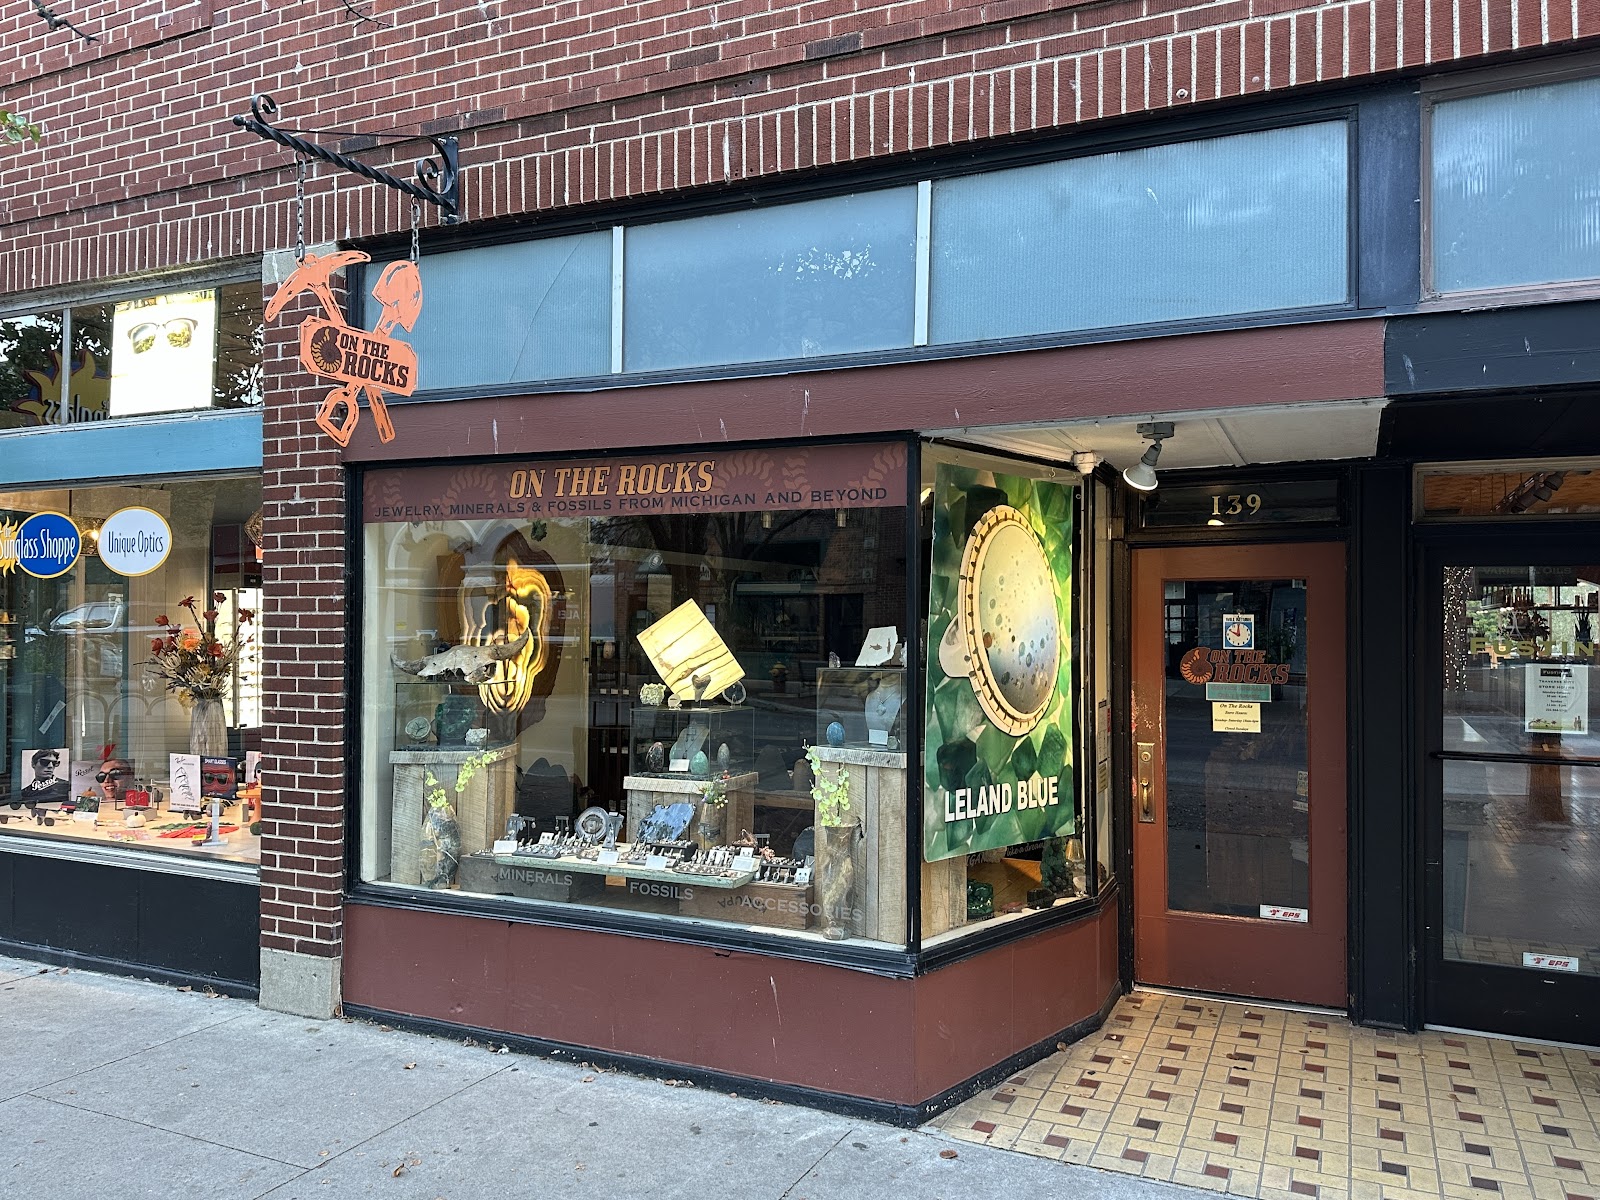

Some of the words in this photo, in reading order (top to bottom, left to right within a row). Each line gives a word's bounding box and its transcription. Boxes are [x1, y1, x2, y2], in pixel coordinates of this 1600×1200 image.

[339, 333, 360, 352] ON
[362, 339, 390, 360] THE
[341, 351, 409, 388] ROCKS
[509, 469, 546, 499] ON
[554, 466, 611, 497] THE
[616, 460, 715, 496] ROCKS
[374, 505, 444, 518] JEWELRY,
[450, 502, 525, 515] MINERALS
[531, 502, 541, 512] &
[547, 499, 612, 512] FOSSILS
[618, 496, 664, 510] FROM
[671, 493, 756, 509] MICHIGAN
[764, 491, 802, 505] AND
[811, 487, 888, 502] BEYOND
[1211, 494, 1262, 516] 139
[40, 528, 76, 564] Shoppe
[108, 530, 136, 557] Unique
[137, 530, 164, 557] Optics
[1210, 649, 1231, 664] ON
[1234, 650, 1267, 664] THE
[1213, 663, 1291, 685] ROCKS
[75, 765, 94, 777] Persol
[31, 776, 59, 791] Persol
[944, 782, 1013, 823] LELAND
[1017, 775, 1059, 811] BLUE
[500, 867, 573, 886] MINERALS
[629, 881, 694, 900] FOSSILS
[741, 894, 865, 922] ACCESSORIES
[1282, 911, 1301, 919] EPS
[1547, 960, 1570, 968] EPS
